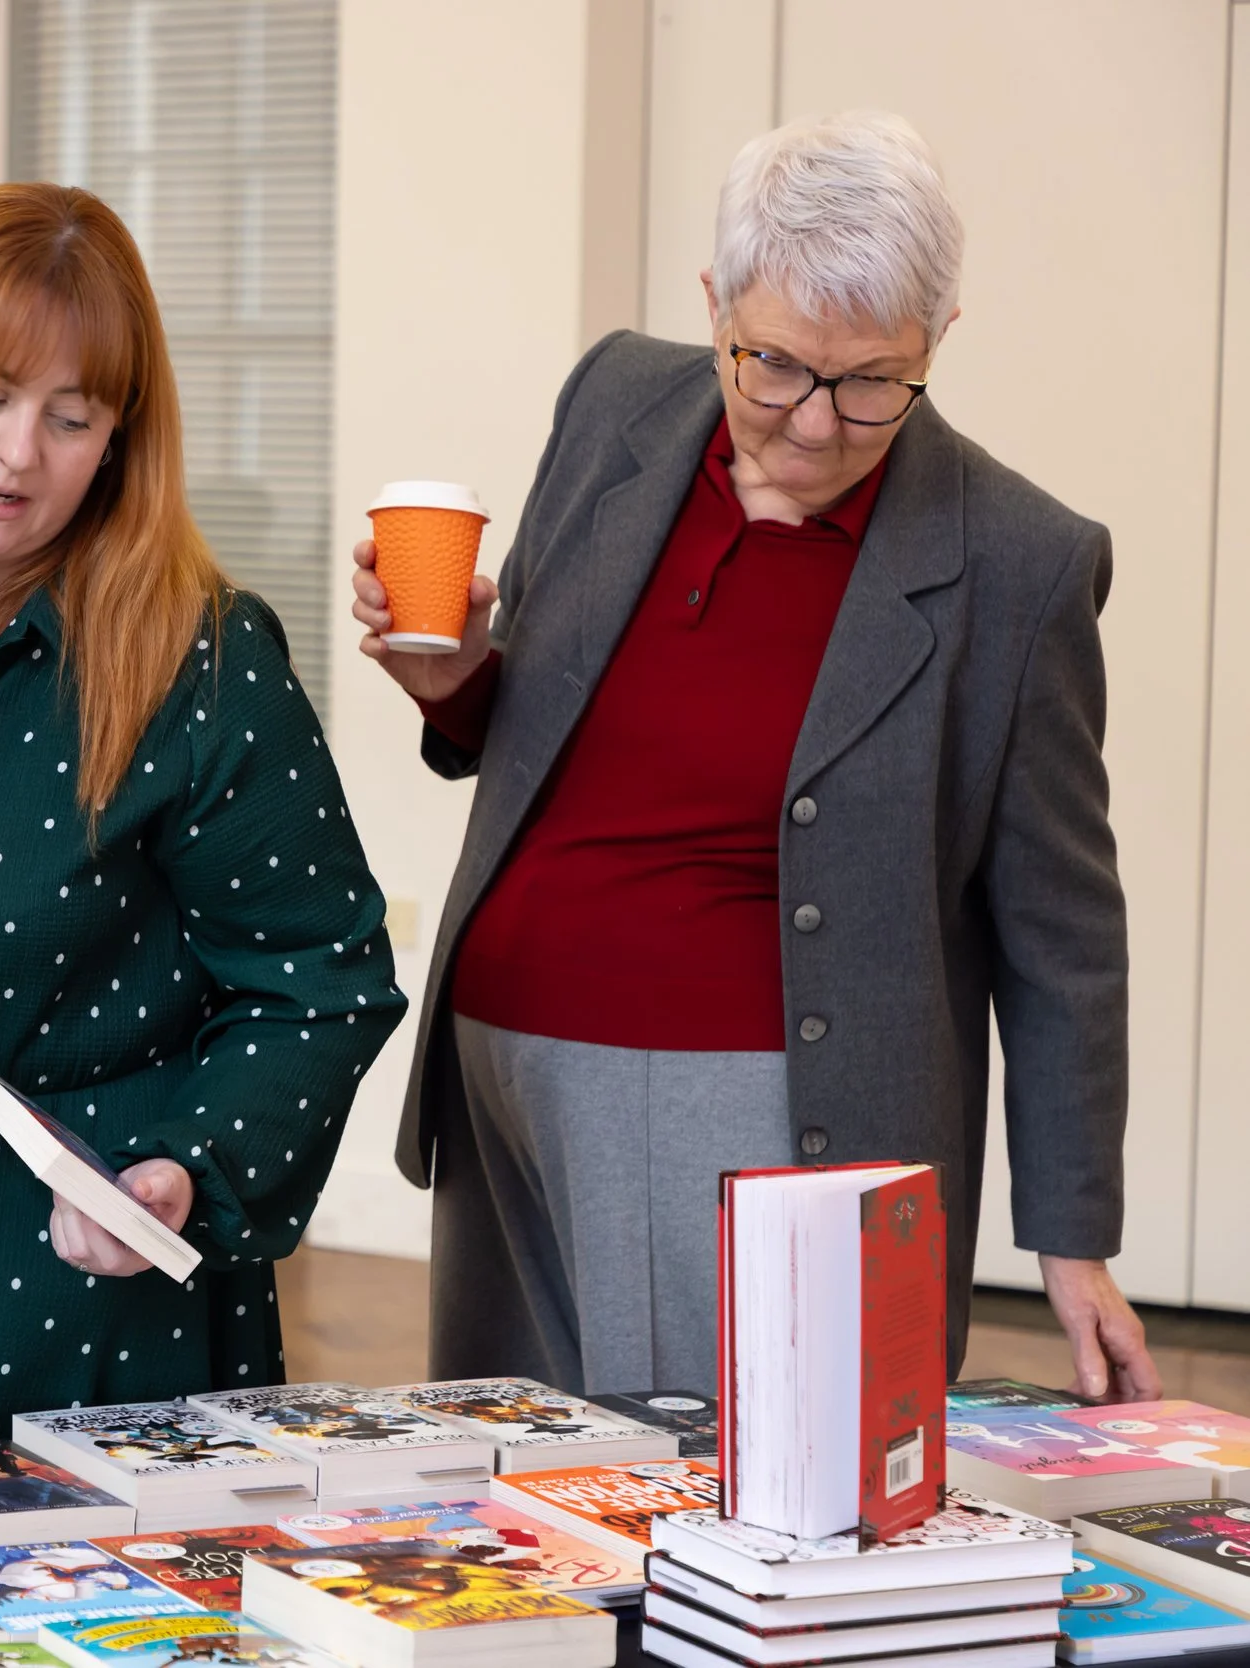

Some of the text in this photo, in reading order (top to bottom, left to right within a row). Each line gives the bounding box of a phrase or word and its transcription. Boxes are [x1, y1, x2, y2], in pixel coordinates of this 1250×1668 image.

[316, 1440, 391, 1453] LANDY
[505, 1434, 578, 1447] LANDY
[133, 1461, 211, 1475] LANDY
[534, 1474, 718, 1503] HAMPION
[565, 1500, 602, 1514] A
[598, 1493, 683, 1511] ARE
[1100, 1507, 1186, 1524] SILVER
